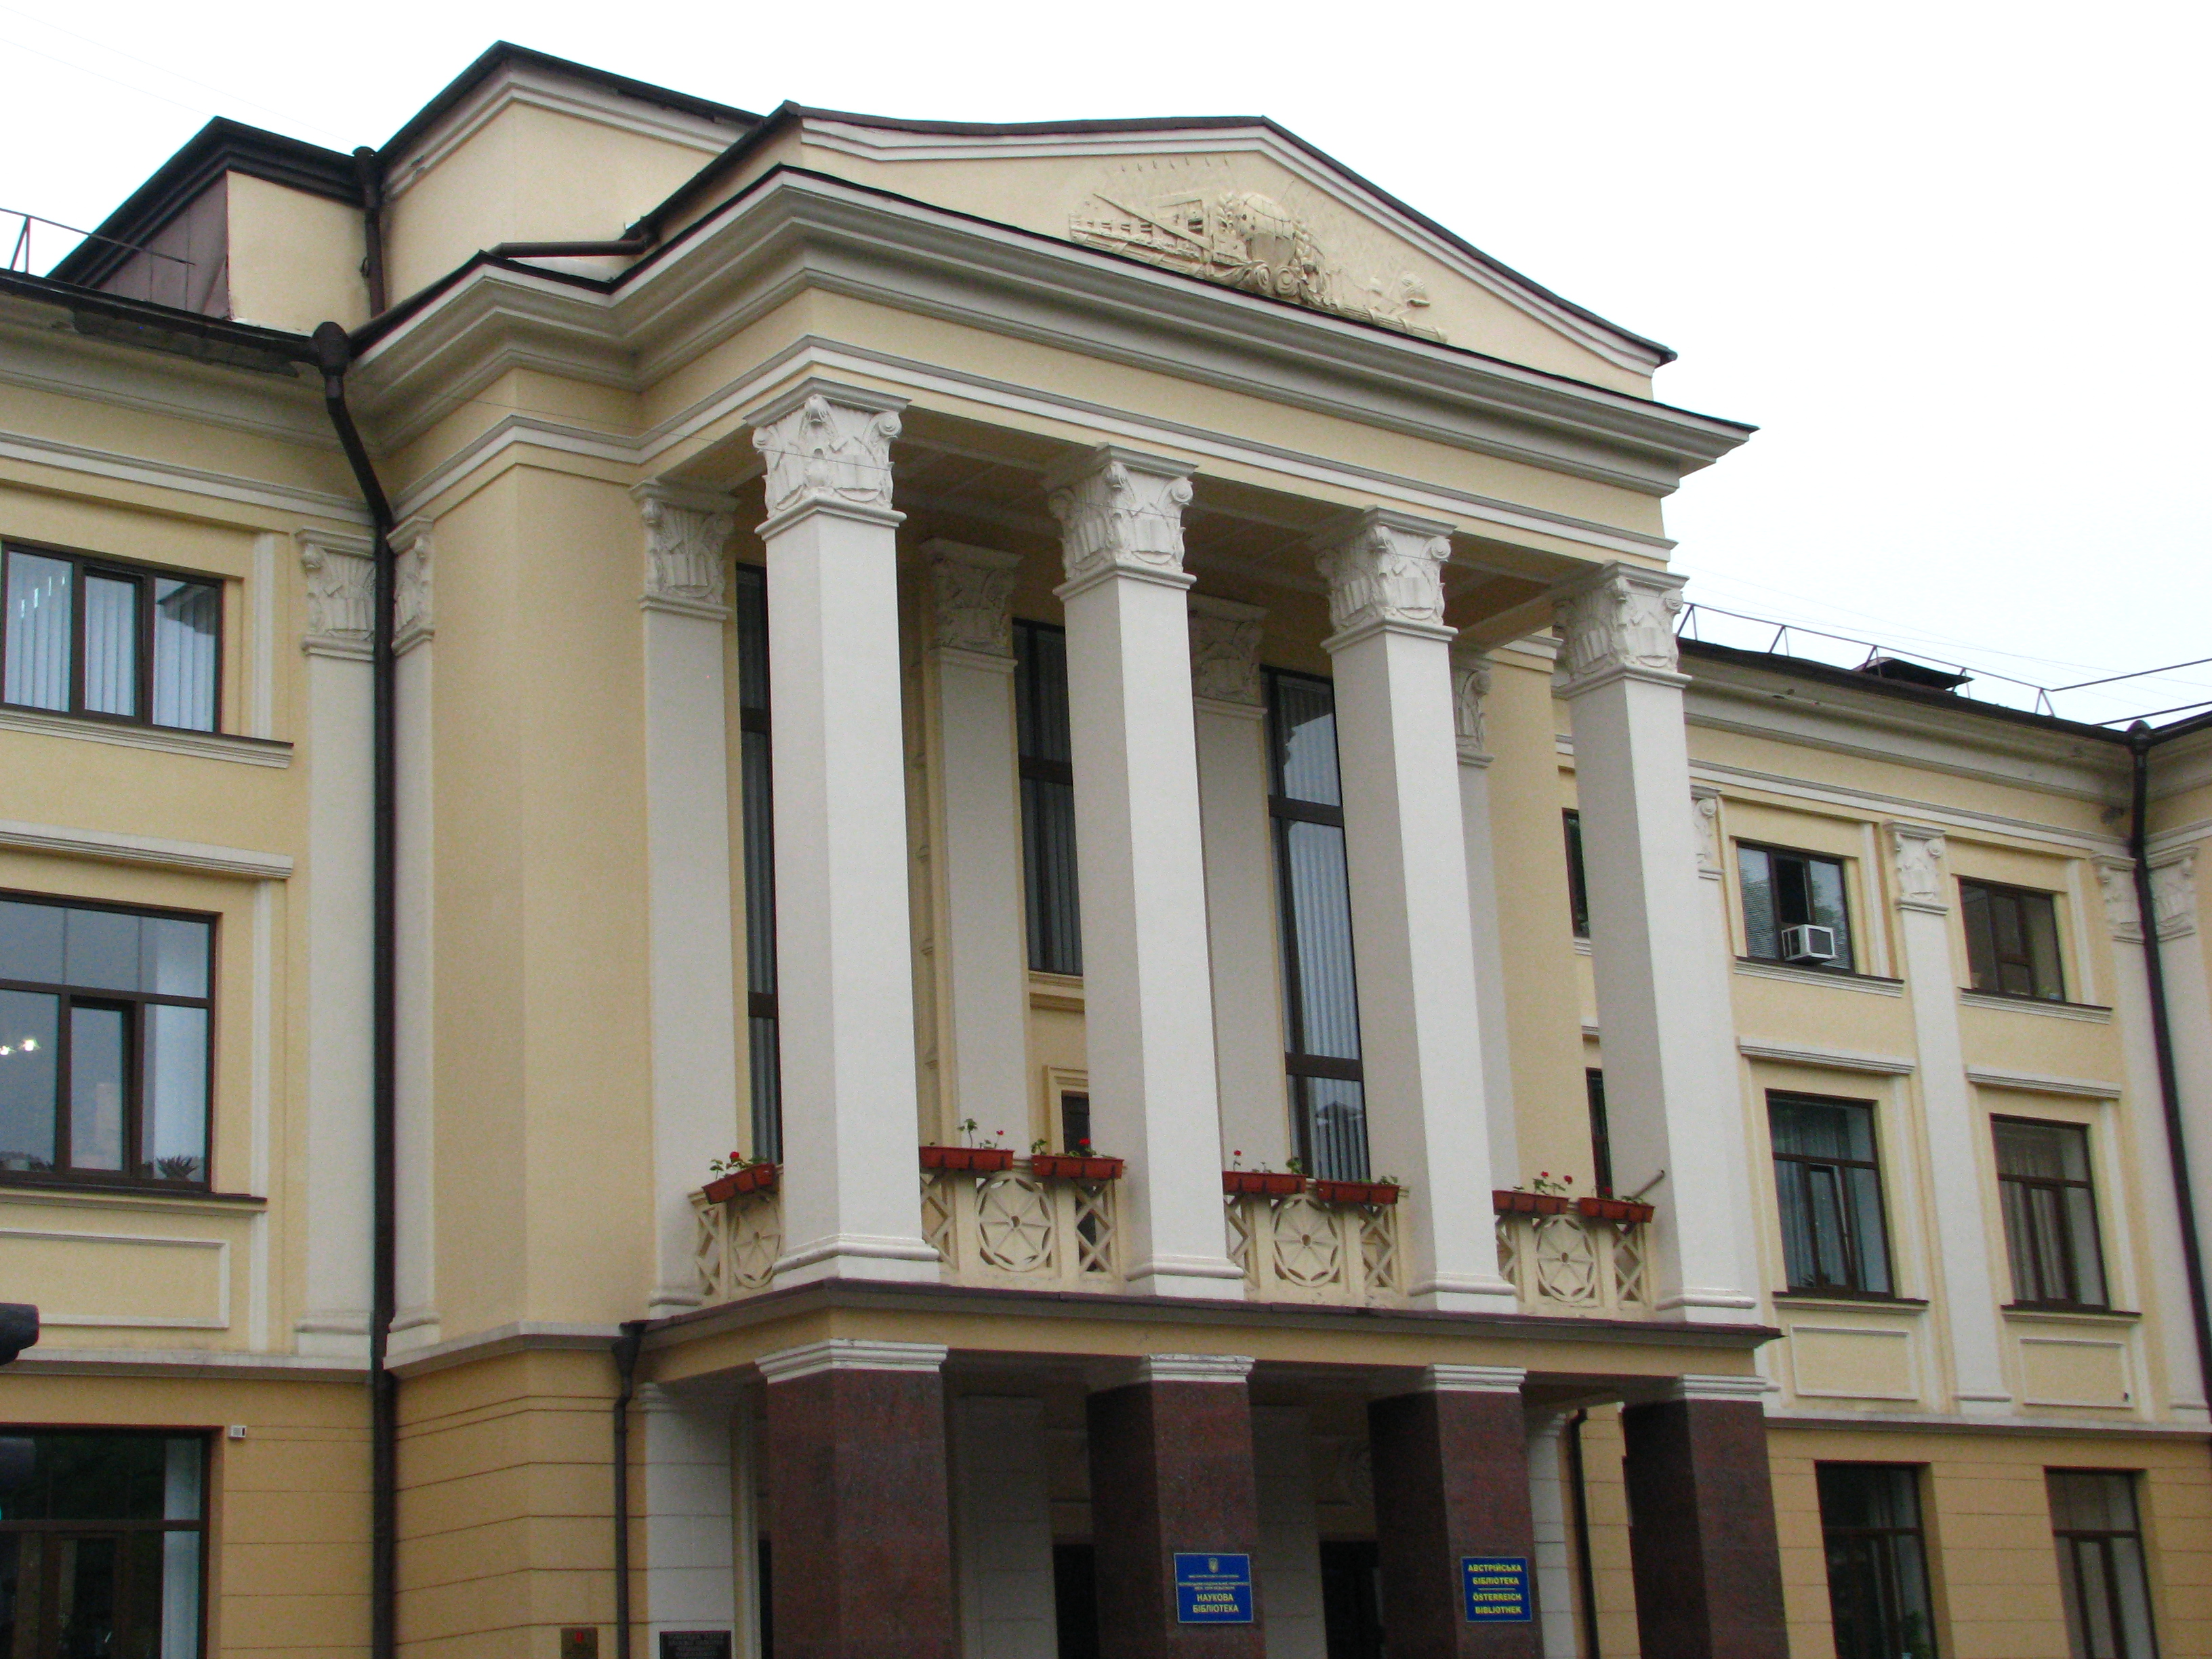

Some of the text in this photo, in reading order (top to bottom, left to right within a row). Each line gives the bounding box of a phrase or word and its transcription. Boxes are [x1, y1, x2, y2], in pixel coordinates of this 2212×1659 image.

[1468, 1563, 1522, 1572] АВСТРІЙСЬКА
[1473, 1577, 1519, 1585] БІБЛІОТЕКА
[1197, 1593, 1234, 1602] НАУКОВА
[1473, 1593, 1522, 1601] ÖSTERREICH
[1193, 1604, 1239, 1613] БІБЛІОТЕКА
[1475, 1605, 1522, 1614] BIBLIOTHEK
